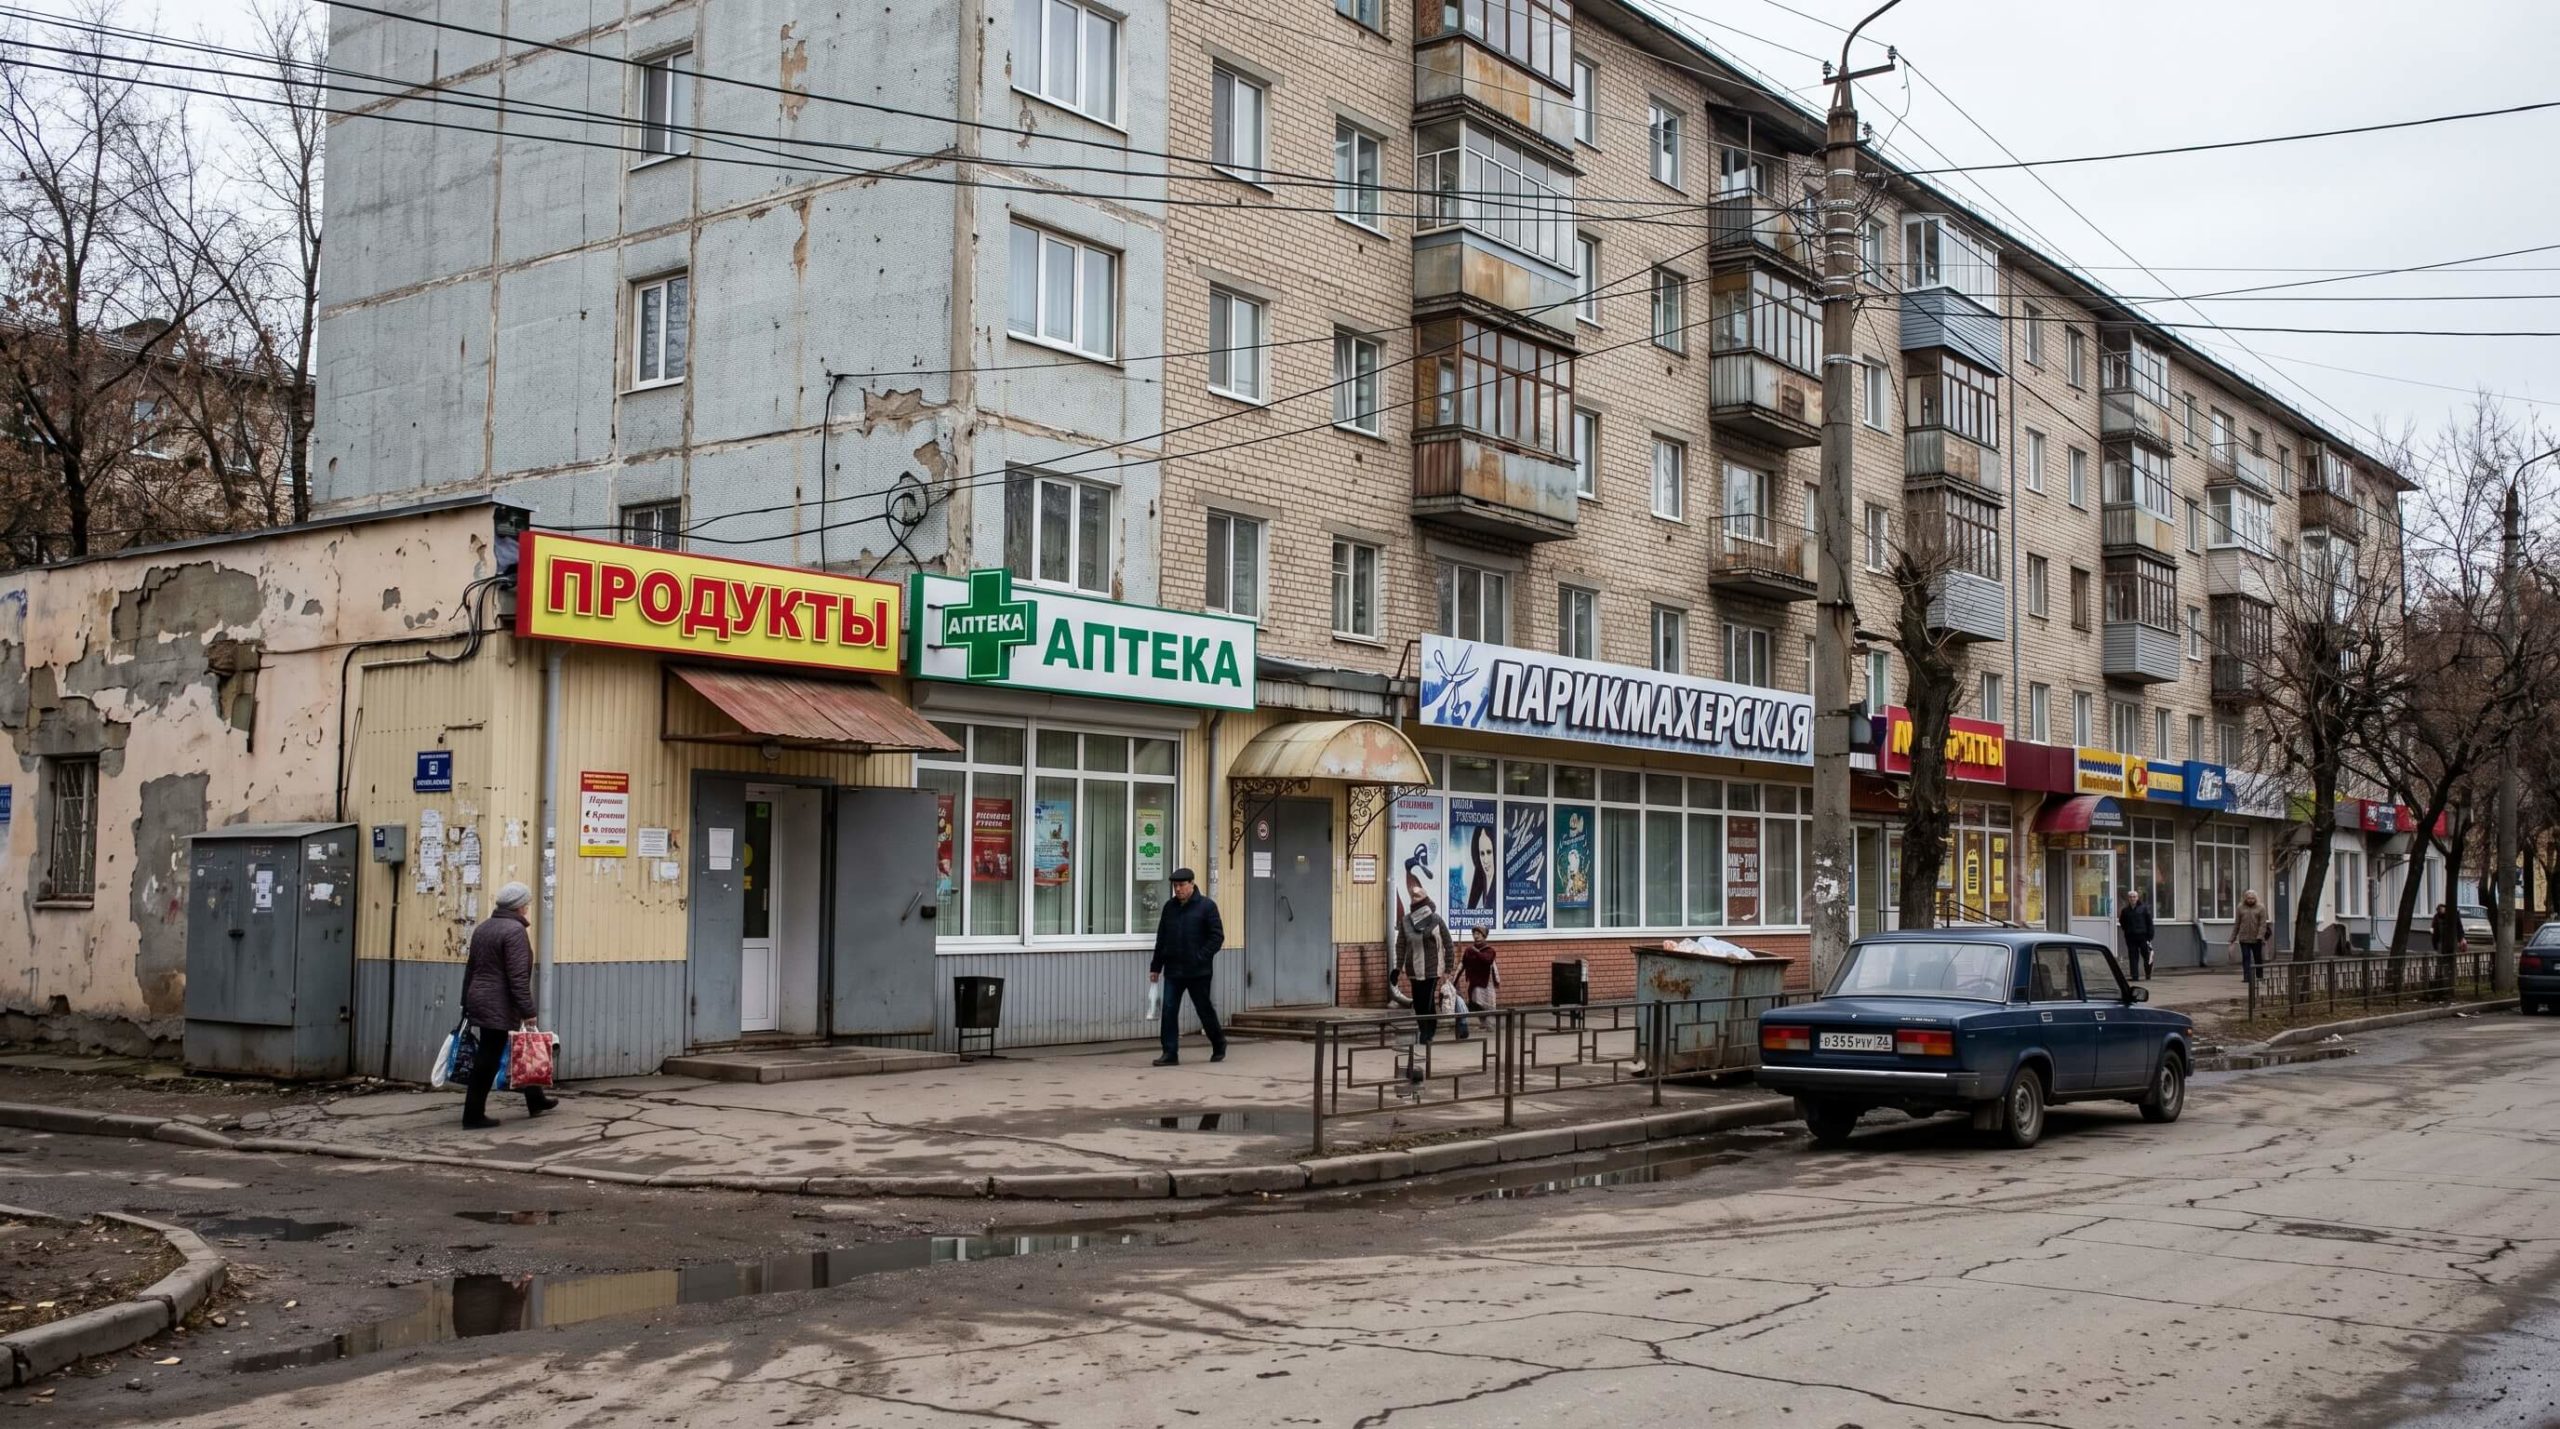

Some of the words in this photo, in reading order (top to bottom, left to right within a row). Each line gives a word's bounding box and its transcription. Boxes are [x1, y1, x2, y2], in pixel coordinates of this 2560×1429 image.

[548, 555, 889, 649] ПРОДУКТЫ
[947, 613, 1025, 635] АПТЕКА
[1042, 618, 1243, 688] АПТЕКА
[1490, 659, 1812, 754] ПАРИКМАХЕРСКАЯ
